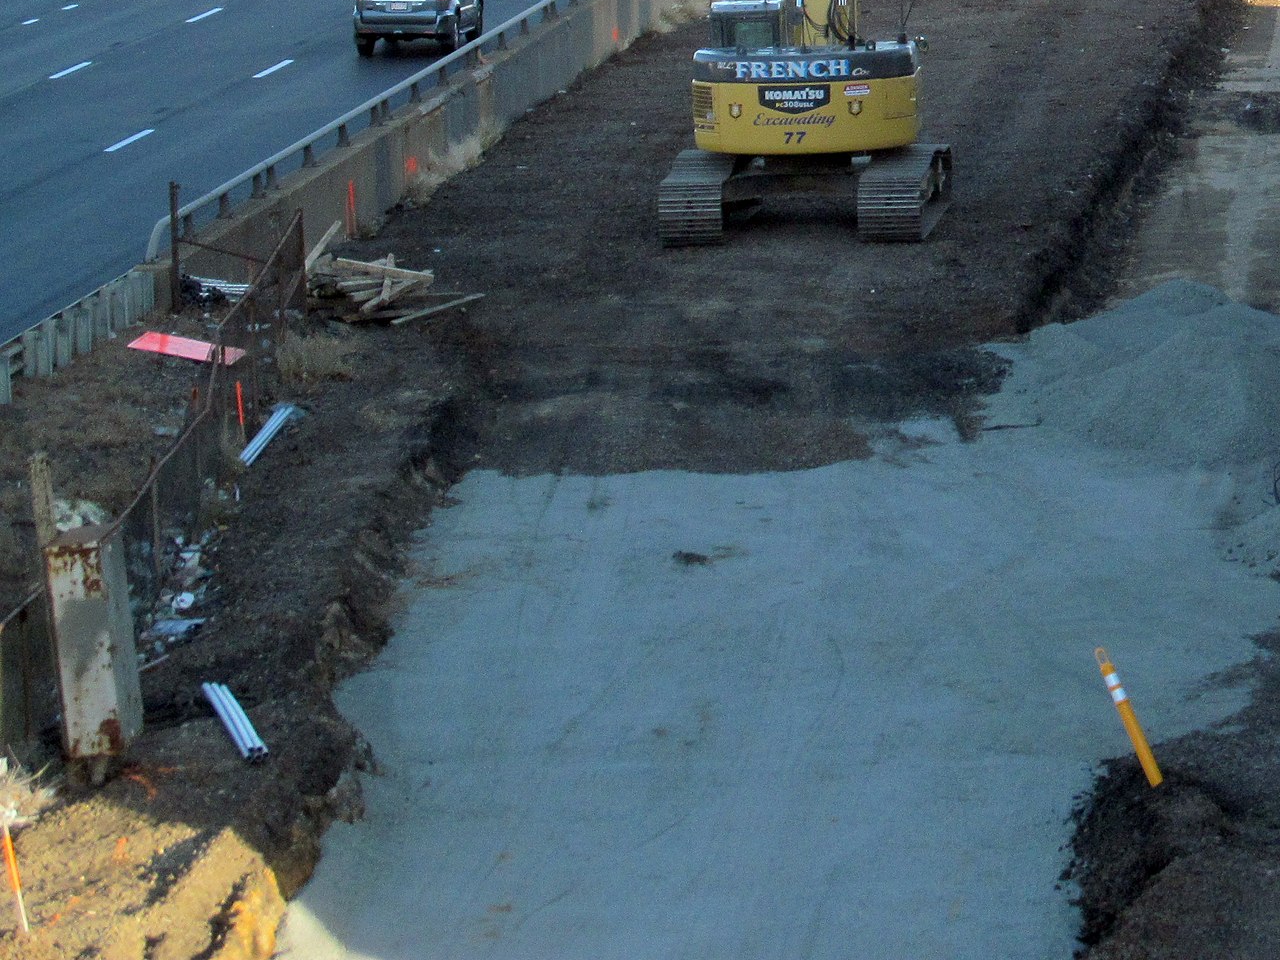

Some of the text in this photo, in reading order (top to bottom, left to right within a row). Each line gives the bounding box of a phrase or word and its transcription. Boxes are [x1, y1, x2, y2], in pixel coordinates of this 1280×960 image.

[735, 59, 851, 79] FRENCH
[764, 88, 824, 100] KOMATSU
[753, 112, 836, 128] Excavating
[783, 131, 807, 144] 77
